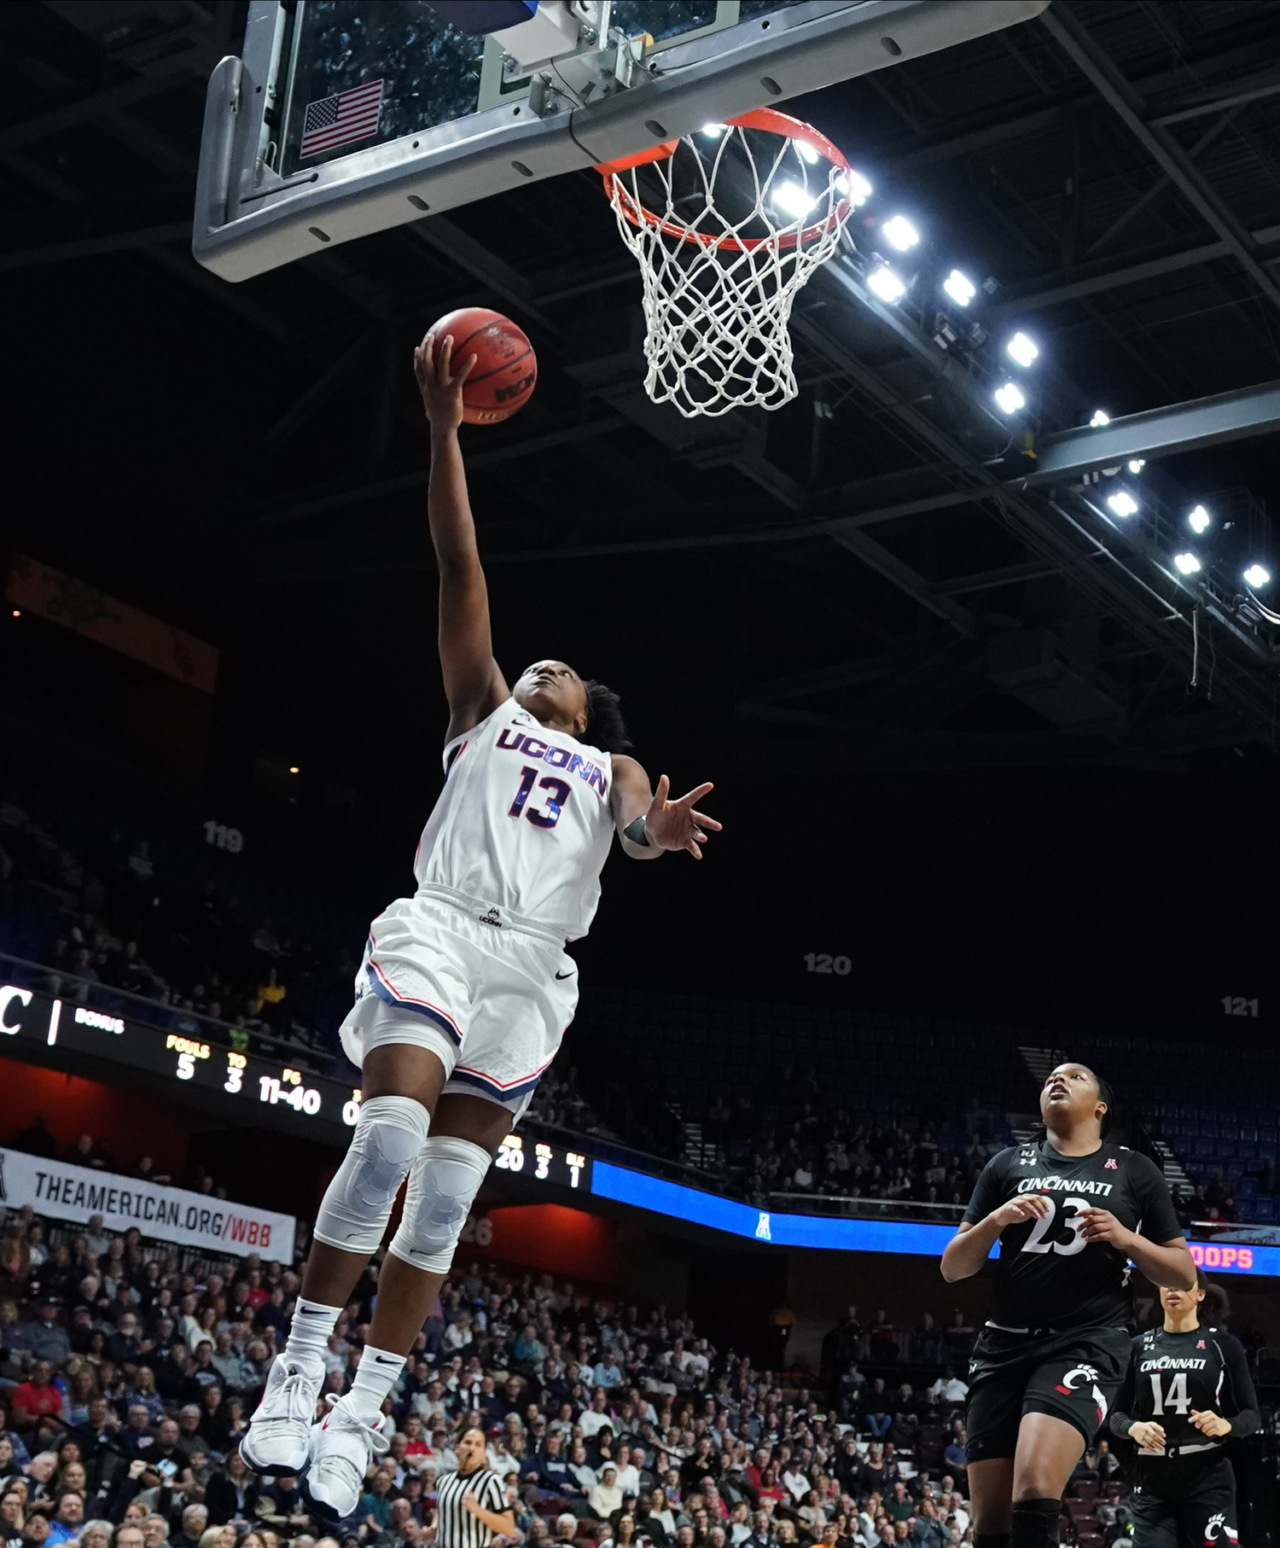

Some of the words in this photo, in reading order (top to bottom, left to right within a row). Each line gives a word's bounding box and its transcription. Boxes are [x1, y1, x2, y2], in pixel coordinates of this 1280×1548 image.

[496, 728, 608, 798] UCONN
[508, 764, 571, 829] 13
[204, 820, 243, 853] 119
[803, 952, 852, 975] 120
[1220, 996, 1259, 1017] 121
[74, 1007, 125, 1035] BONUS
[166, 1034, 210, 1060] FOULS
[227, 1052, 247, 1069] TO
[176, 1053, 195, 1080] 5
[224, 1066, 243, 1094] 3
[282, 1068, 302, 1086] FG
[258, 1075, 322, 1116] 11-40
[495, 1144, 524, 1172] 20
[534, 1156, 549, 1180] 3
[569, 1165, 580, 1188] 1
[1017, 1175, 1113, 1197] CINCINNATI
[35, 1171, 272, 1248] THEAMERICAN.ORG/WBB
[1020, 1195, 1092, 1256] 23
[1140, 1355, 1206, 1373] CINCINNATI
[1149, 1372, 1192, 1416] 14
